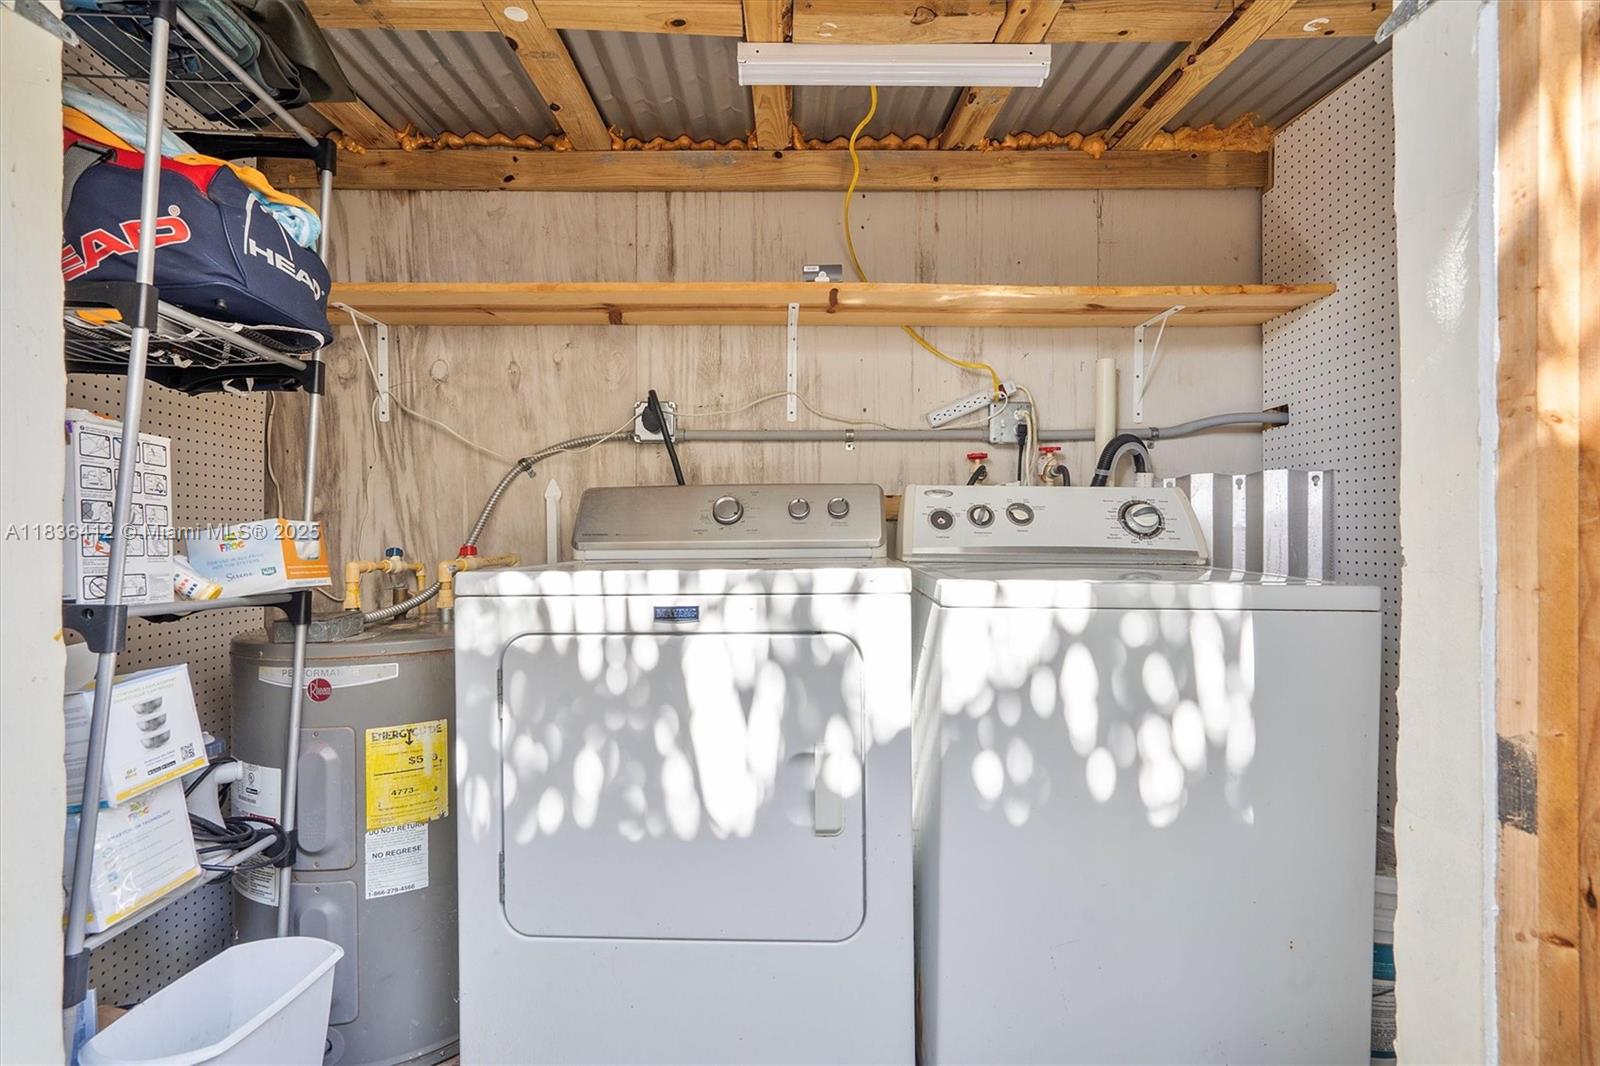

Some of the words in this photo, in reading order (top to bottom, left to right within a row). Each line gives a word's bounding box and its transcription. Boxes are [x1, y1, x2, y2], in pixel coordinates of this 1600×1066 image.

[62, 216, 190, 281] EAD
[249, 238, 320, 301] HEAD
[391, 787, 414, 796] 4773
[371, 851, 384, 859] NO
[385, 844, 422, 857] REGRESE
